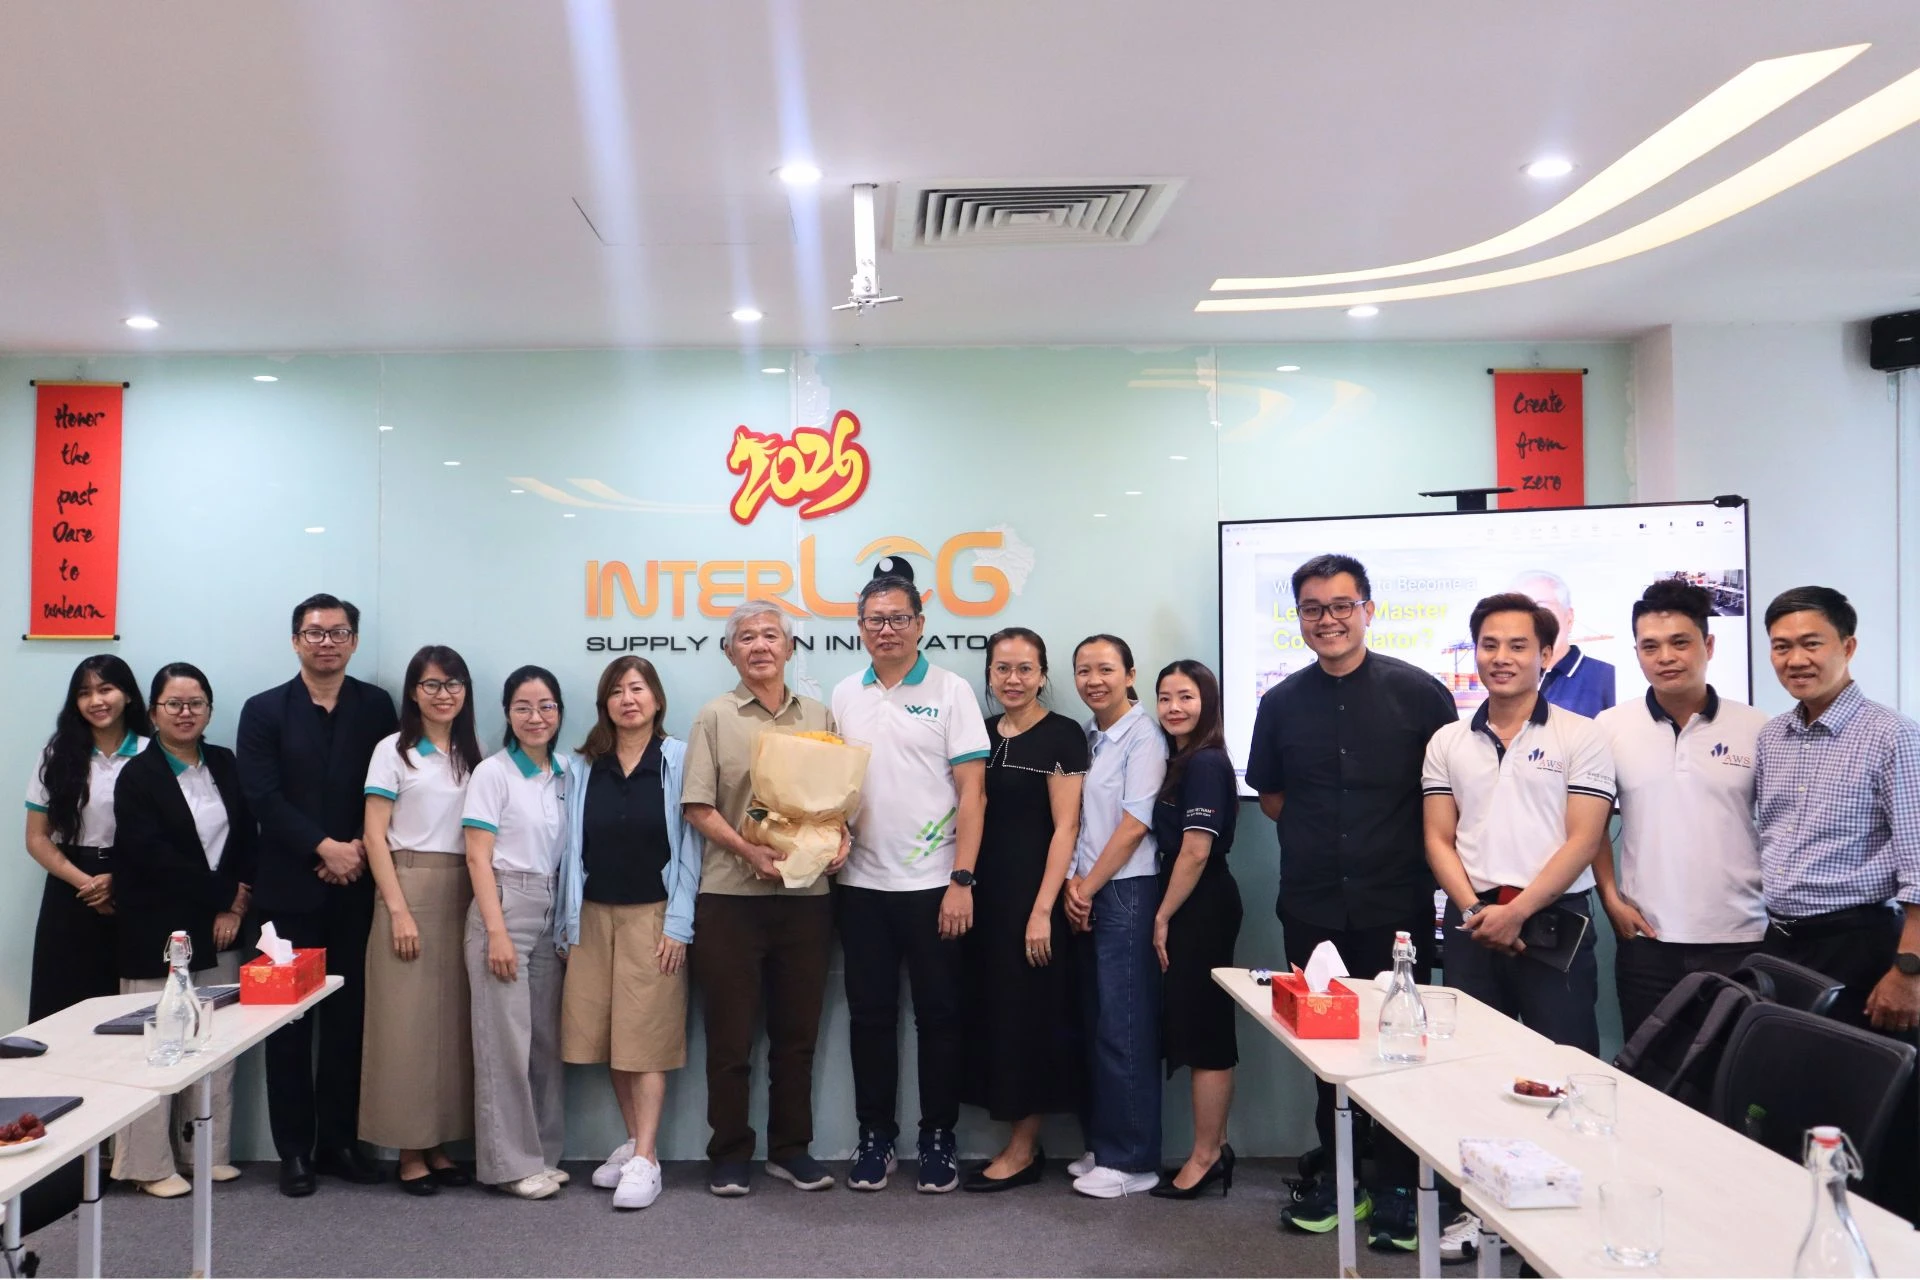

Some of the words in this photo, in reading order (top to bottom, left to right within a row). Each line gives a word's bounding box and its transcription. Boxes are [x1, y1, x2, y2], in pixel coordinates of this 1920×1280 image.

[1513, 388, 1566, 414] Create
[54, 403, 105, 429] Honor
[61, 443, 91, 465] the
[1516, 431, 1568, 459] from
[729, 415, 866, 520] 2026
[1521, 474, 1562, 491] zero
[57, 482, 98, 514] past
[52, 521, 95, 543] Dare
[59, 559, 80, 581] to
[1398, 576, 1462, 592] Become
[44, 595, 106, 619] unlearn
[1373, 599, 1449, 621] Master
[586, 635, 709, 652] SUPPLY
